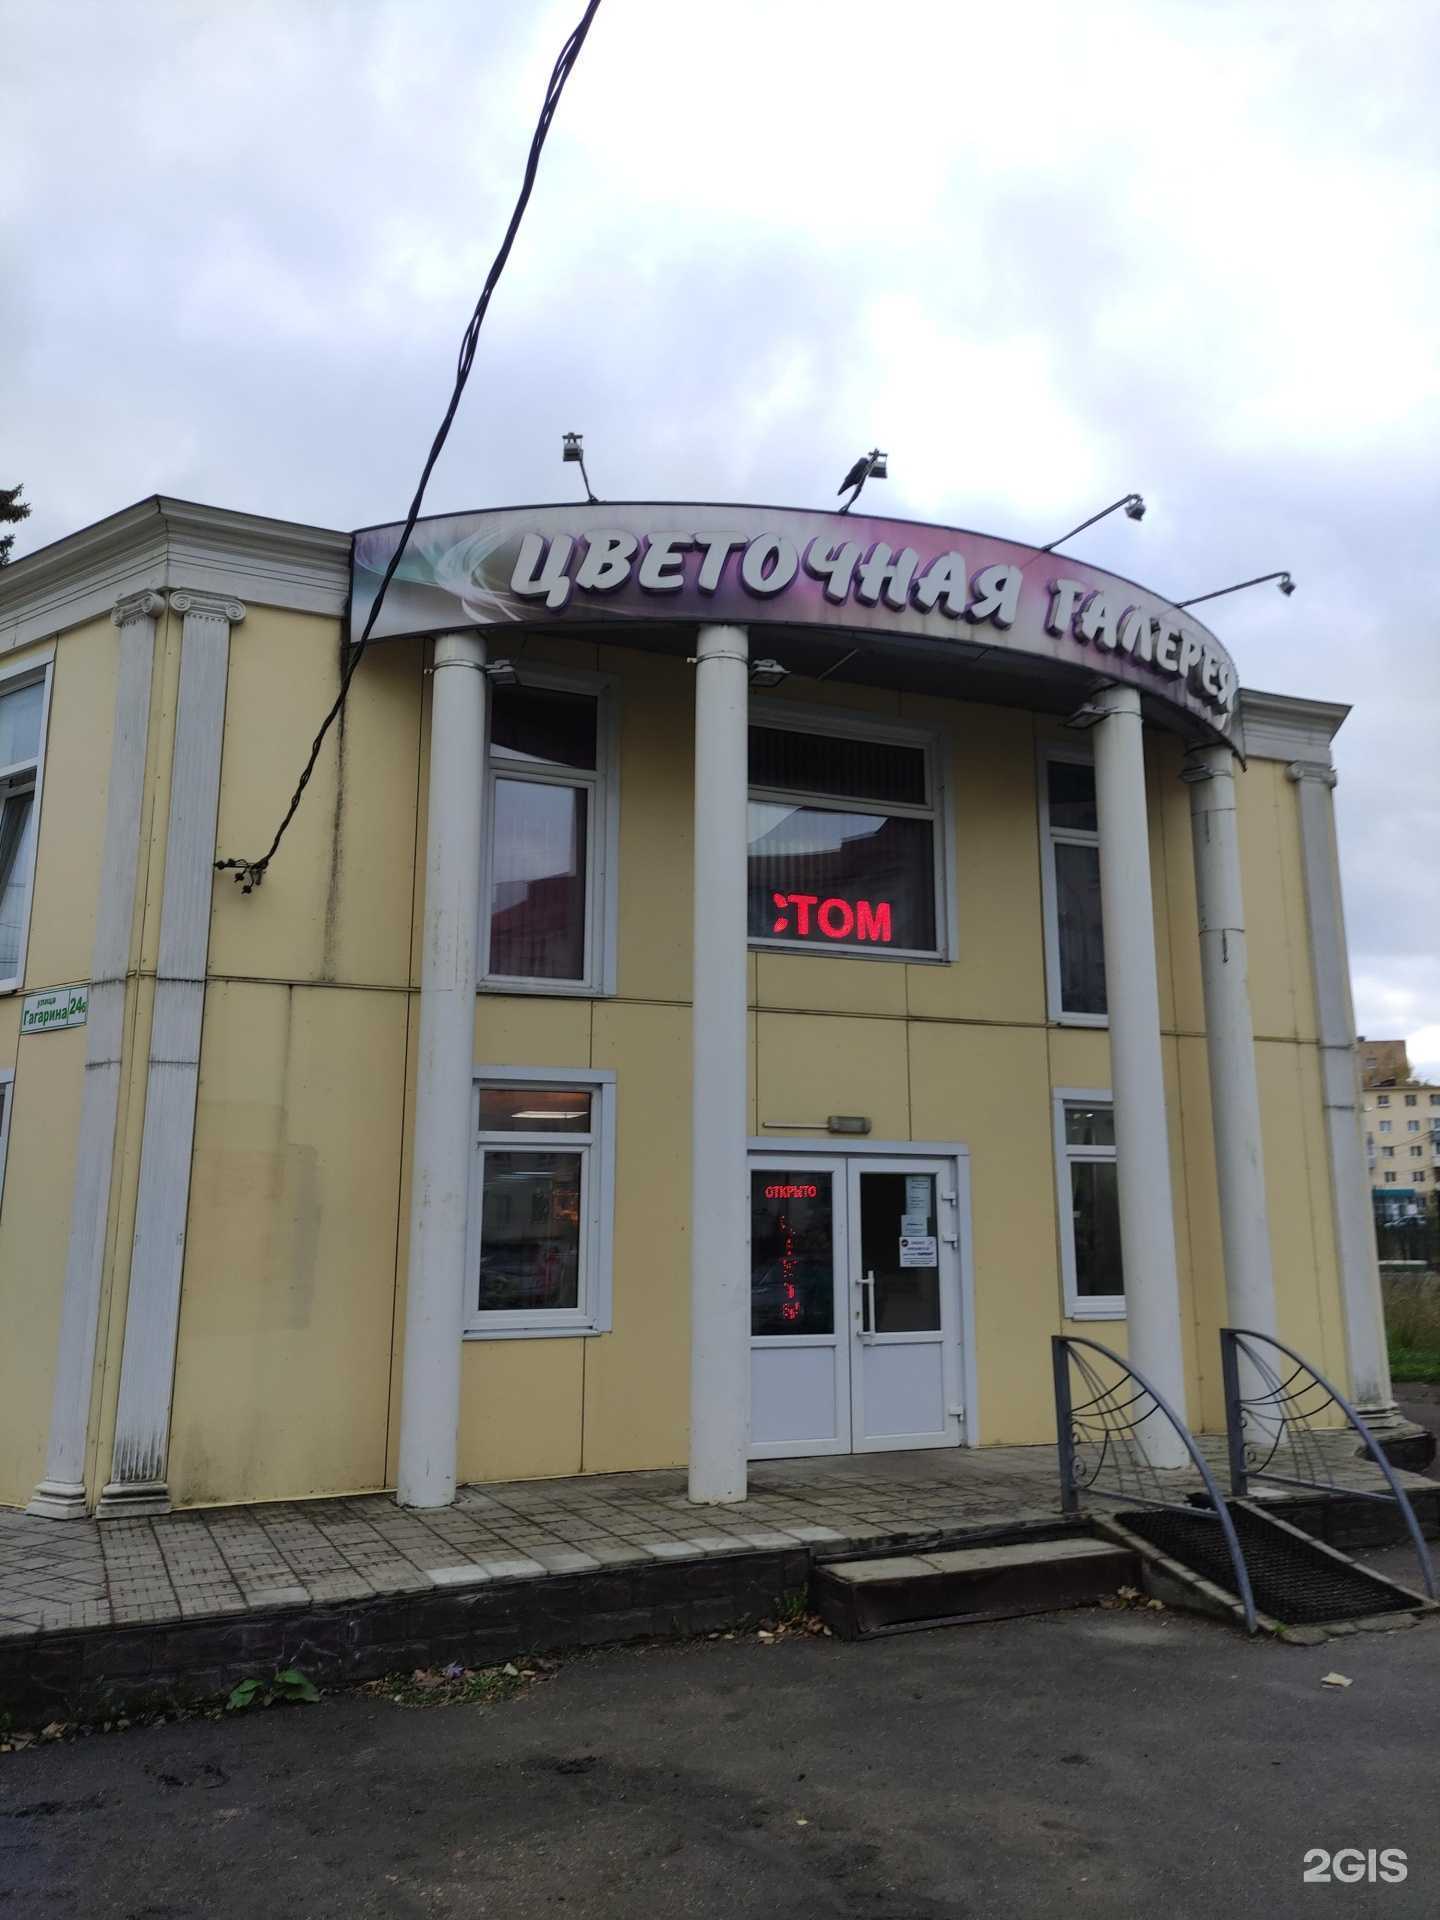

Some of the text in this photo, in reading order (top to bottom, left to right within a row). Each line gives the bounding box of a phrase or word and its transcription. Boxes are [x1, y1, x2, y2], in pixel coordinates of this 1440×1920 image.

[509, 530, 1236, 713] ЦВЕТОЧНАЯ ГАЛЕРЕЯ
[23, 1007, 69, 1026] Гагарина
[764, 1184, 817, 1199] ОТКРЫТО
